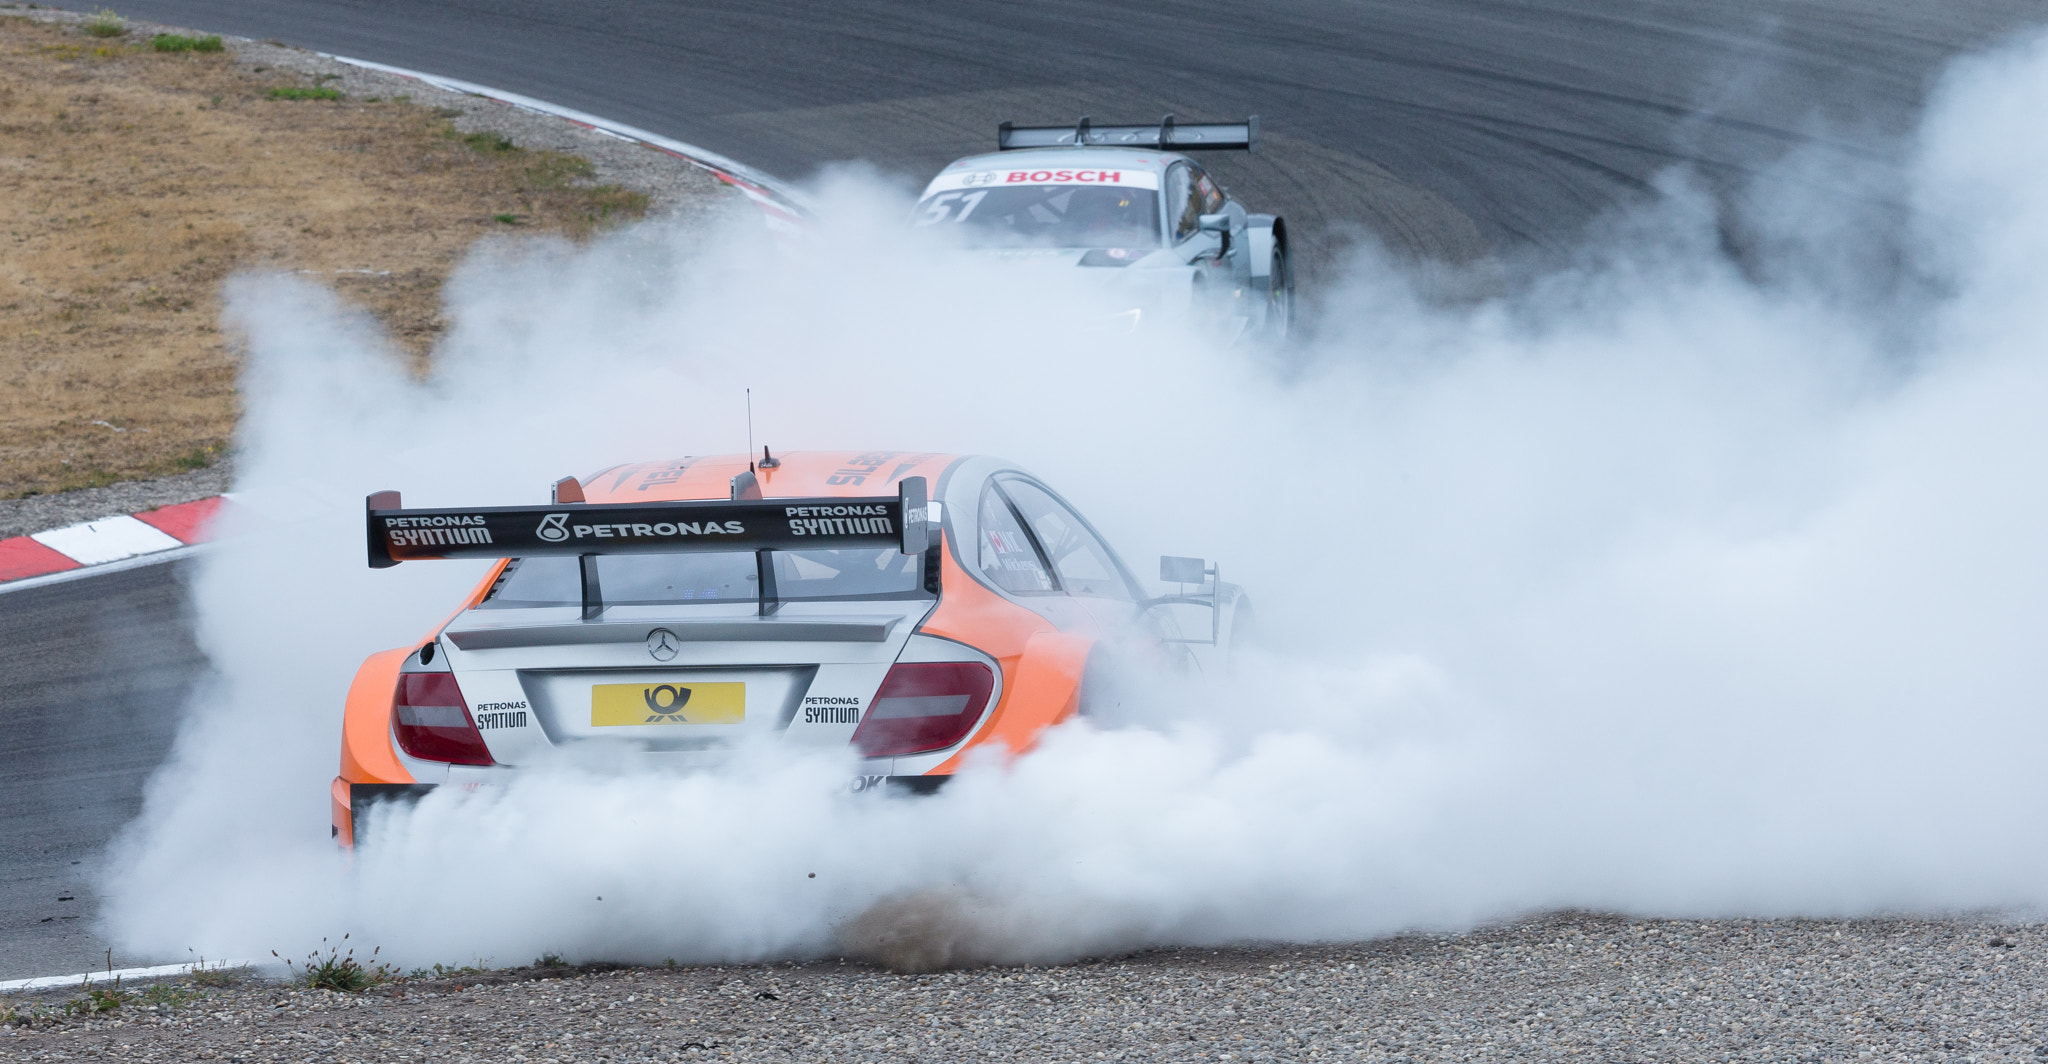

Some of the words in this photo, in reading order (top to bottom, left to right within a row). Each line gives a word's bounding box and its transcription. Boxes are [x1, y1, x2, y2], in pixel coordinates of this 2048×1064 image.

[1006, 171, 1121, 183] BOSCH
[914, 190, 989, 226] 51
[785, 505, 888, 517] PETRONAS
[385, 515, 486, 527] PETRONAS
[573, 520, 745, 538] PETRONAS
[789, 517, 893, 536] SYNTIUM
[389, 527, 493, 546] SYNTIUM
[477, 701, 527, 711] PETRONAS
[805, 697, 859, 705] PETRONAS
[477, 711, 527, 730] SYNTIUM
[805, 707, 859, 723] SYNTIUM
